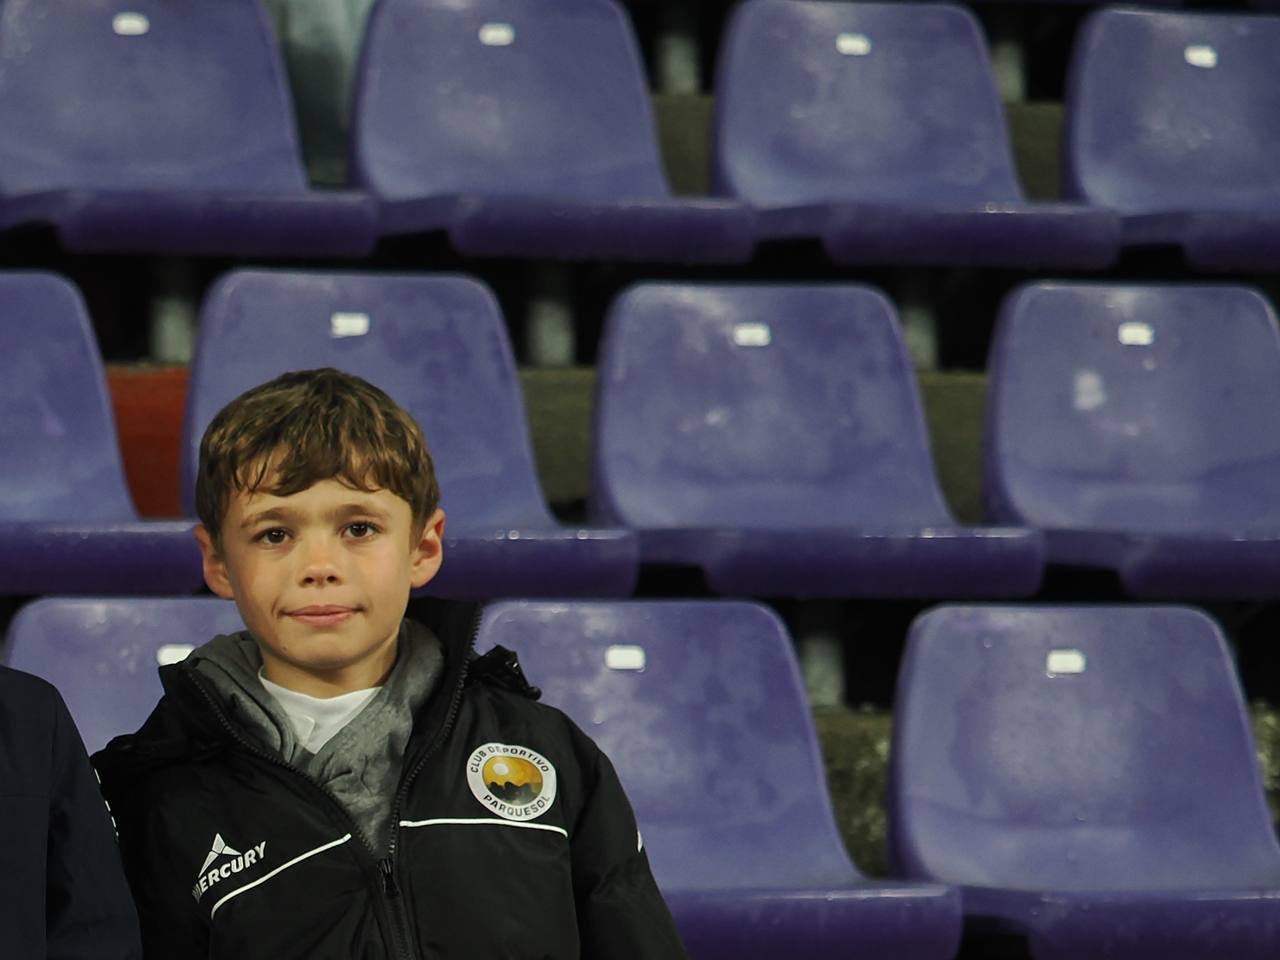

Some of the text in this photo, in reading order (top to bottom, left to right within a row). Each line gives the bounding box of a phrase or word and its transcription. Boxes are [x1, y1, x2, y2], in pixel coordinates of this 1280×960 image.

[471, 746, 549, 773] CLUB DEPORTIVO
[483, 794, 550, 817] PARQUESOL
